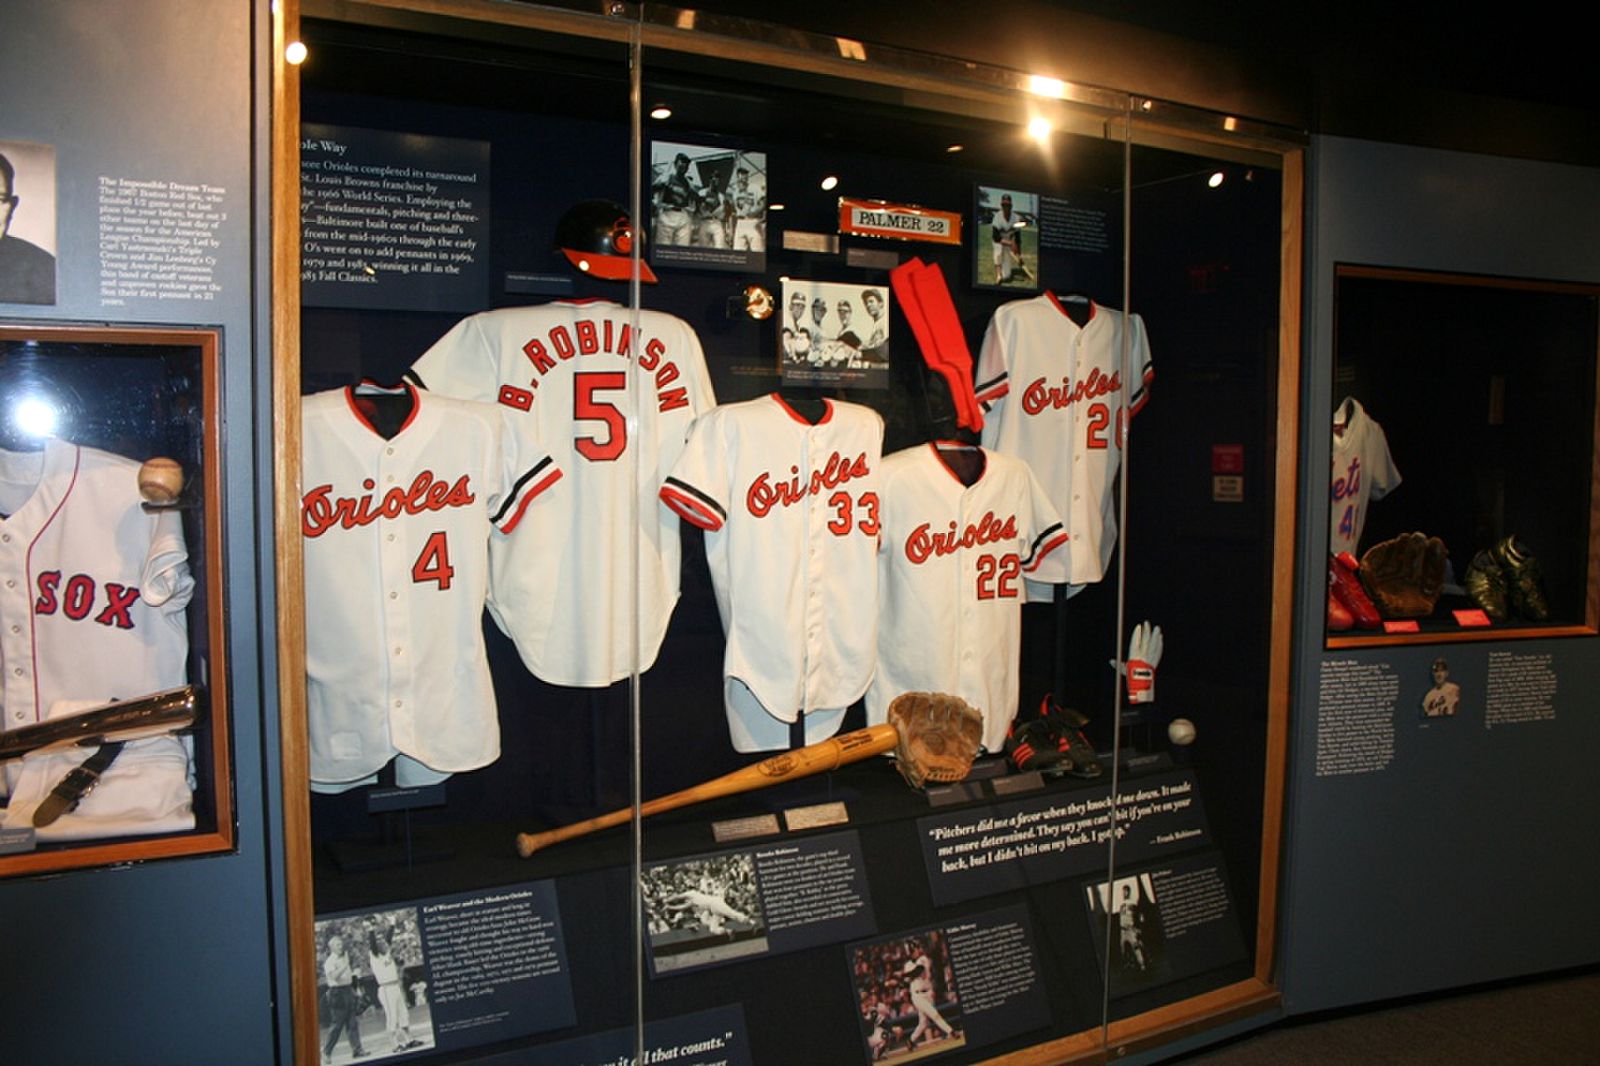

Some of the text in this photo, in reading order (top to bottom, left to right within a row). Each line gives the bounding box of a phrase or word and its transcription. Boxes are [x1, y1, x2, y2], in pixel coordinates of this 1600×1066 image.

[320, 140, 347, 156] Way
[99, 177, 117, 186] The
[316, 174, 342, 184] Louis
[344, 176, 380, 188] Browns
[383, 179, 424, 192] franchise
[426, 183, 438, 195] by
[324, 161, 358, 172] Orioles
[361, 166, 410, 177] completed
[412, 168, 423, 176] its
[426, 171, 476, 182] turnaround
[342, 190, 372, 200] World
[406, 194, 456, 210] Employing
[457, 199, 472, 209] the
[392, 208, 432, 221] pitching
[433, 210, 450, 220] and
[366, 218, 388, 229] built
[409, 222, 421, 231] of
[859, 212, 944, 233] PALMER 22
[304, 228, 328, 239] from
[330, 230, 346, 240] the
[400, 234, 436, 248] through
[438, 236, 452, 247] the
[454, 238, 477, 250] early
[304, 242, 321, 253] O's
[376, 247, 394, 256] add
[395, 250, 436, 260] pennants
[438, 251, 449, 260] in
[319, 271, 336, 281] Fall
[327, 258, 345, 267] and
[372, 262, 409, 274] winning
[420, 262, 432, 272] all
[433, 264, 443, 272] in
[445, 264, 460, 274] the
[1021, 367, 1122, 415] Orioles
[574, 371, 627, 462] 5
[746, 451, 869, 518] Orioles
[302, 470, 474, 538] Orioles
[827, 491, 880, 536] 33
[905, 511, 1018, 564] Orioles
[412, 531, 454, 590] 4
[976, 553, 1021, 600] 22
[35, 570, 140, 630] SOX
[978, 818, 993, 832] did
[994, 821, 1008, 829] me
[1016, 812, 1041, 828] favor
[1043, 806, 1066, 819] when
[1068, 803, 1085, 816] they
[1087, 794, 1122, 812] knockd
[1123, 795, 1135, 804] me
[1136, 790, 1160, 802] down.
[1161, 786, 1169, 796] It
[1170, 781, 1191, 794] made
[938, 847, 954, 856] me
[955, 841, 980, 853] more
[981, 828, 1036, 848] determined.
[1037, 824, 1059, 836] They
[1061, 822, 1076, 833] say
[1077, 820, 1094, 831] you
[1116, 808, 1127, 819] hit
[1130, 806, 1137, 820] if
[1137, 804, 1162, 819] you're
[1163, 802, 1172, 811] on
[1173, 798, 1191, 812] your
[942, 858, 969, 873] back,
[970, 855, 986, 867] but
[988, 852, 992, 863] I
[994, 846, 1022, 861] didn't
[1024, 844, 1037, 855] hit
[1039, 842, 1051, 853] on
[1052, 840, 1065, 851] my
[1066, 833, 1090, 847] back.
[1092, 830, 1096, 841] I
[651, 1047, 678, 1063] that
[681, 1032, 733, 1056] counts."
